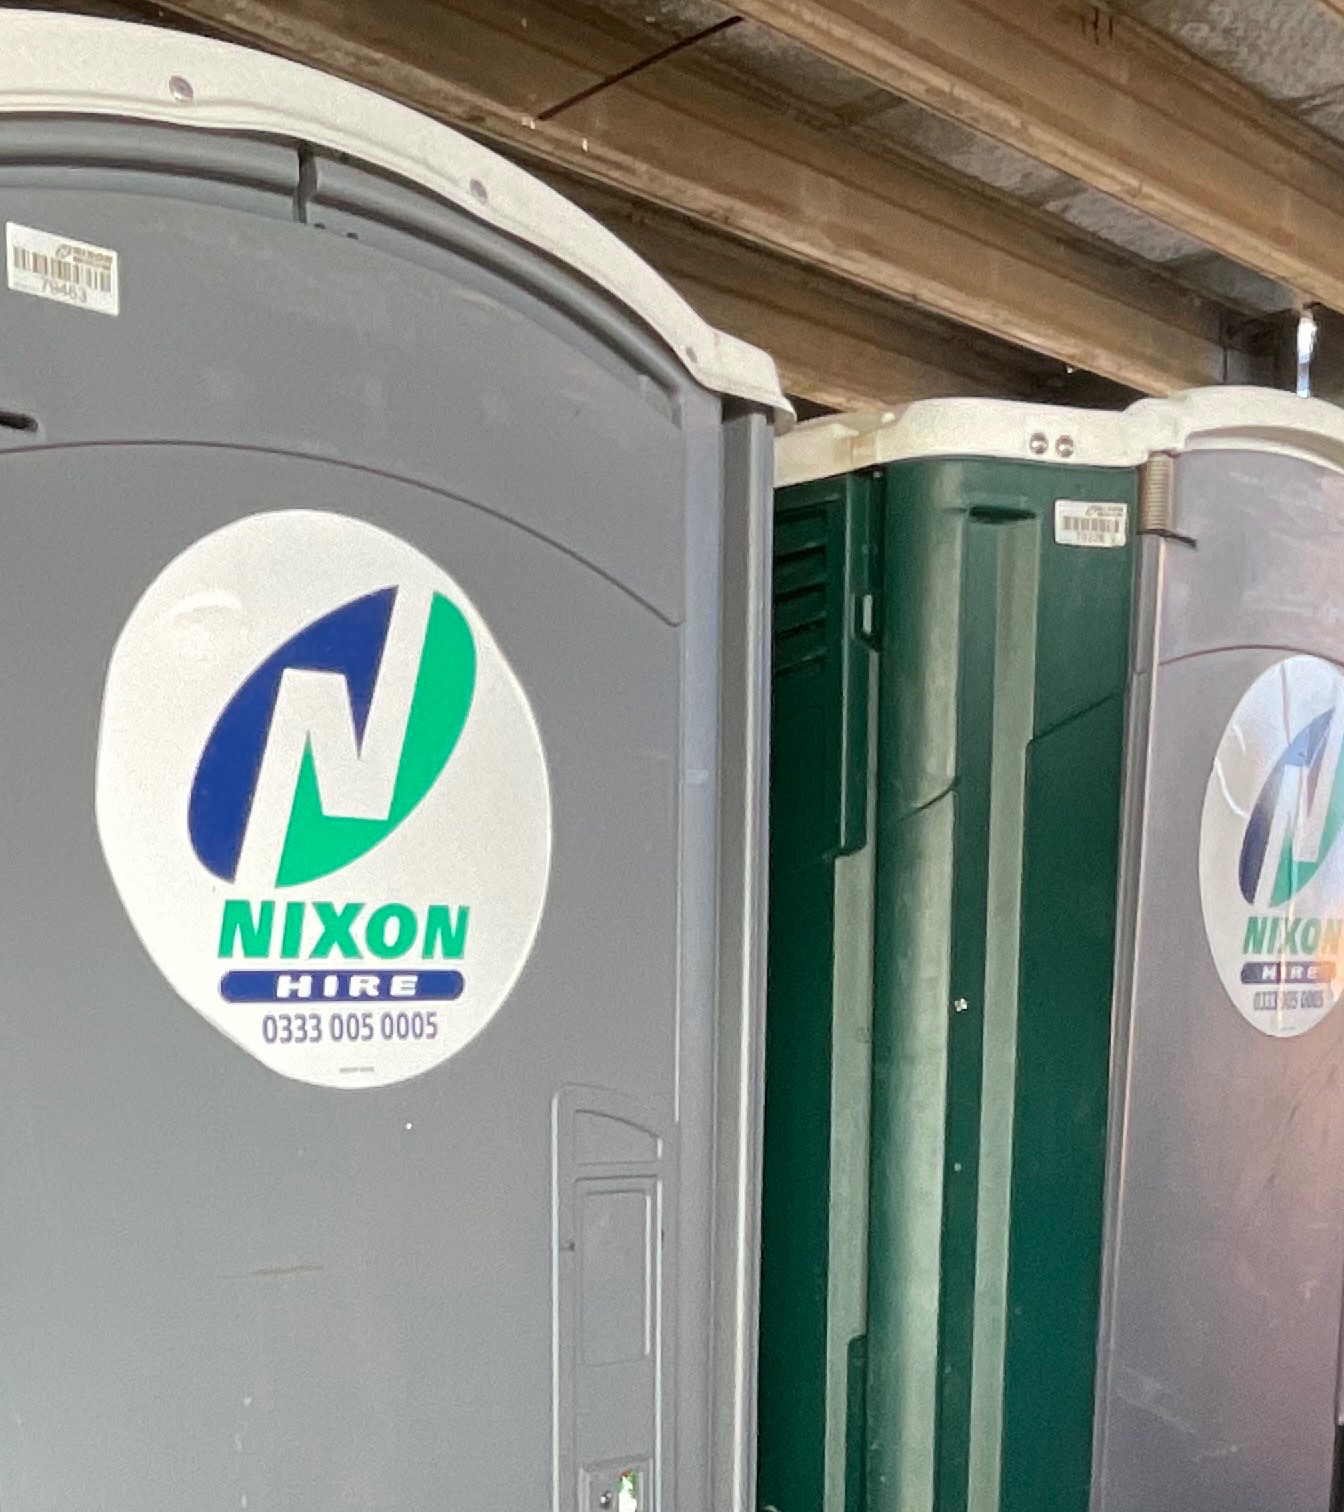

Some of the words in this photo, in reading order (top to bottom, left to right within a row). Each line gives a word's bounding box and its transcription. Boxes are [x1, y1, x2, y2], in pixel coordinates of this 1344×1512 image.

[218, 899, 470, 960] NIXON
[1243, 916, 1343, 955] NIXON
[275, 974, 418, 998] HIRE
[262, 1013, 322, 1044] 0333
[329, 1012, 374, 1042] 005
[380, 1011, 438, 1040] 0005
